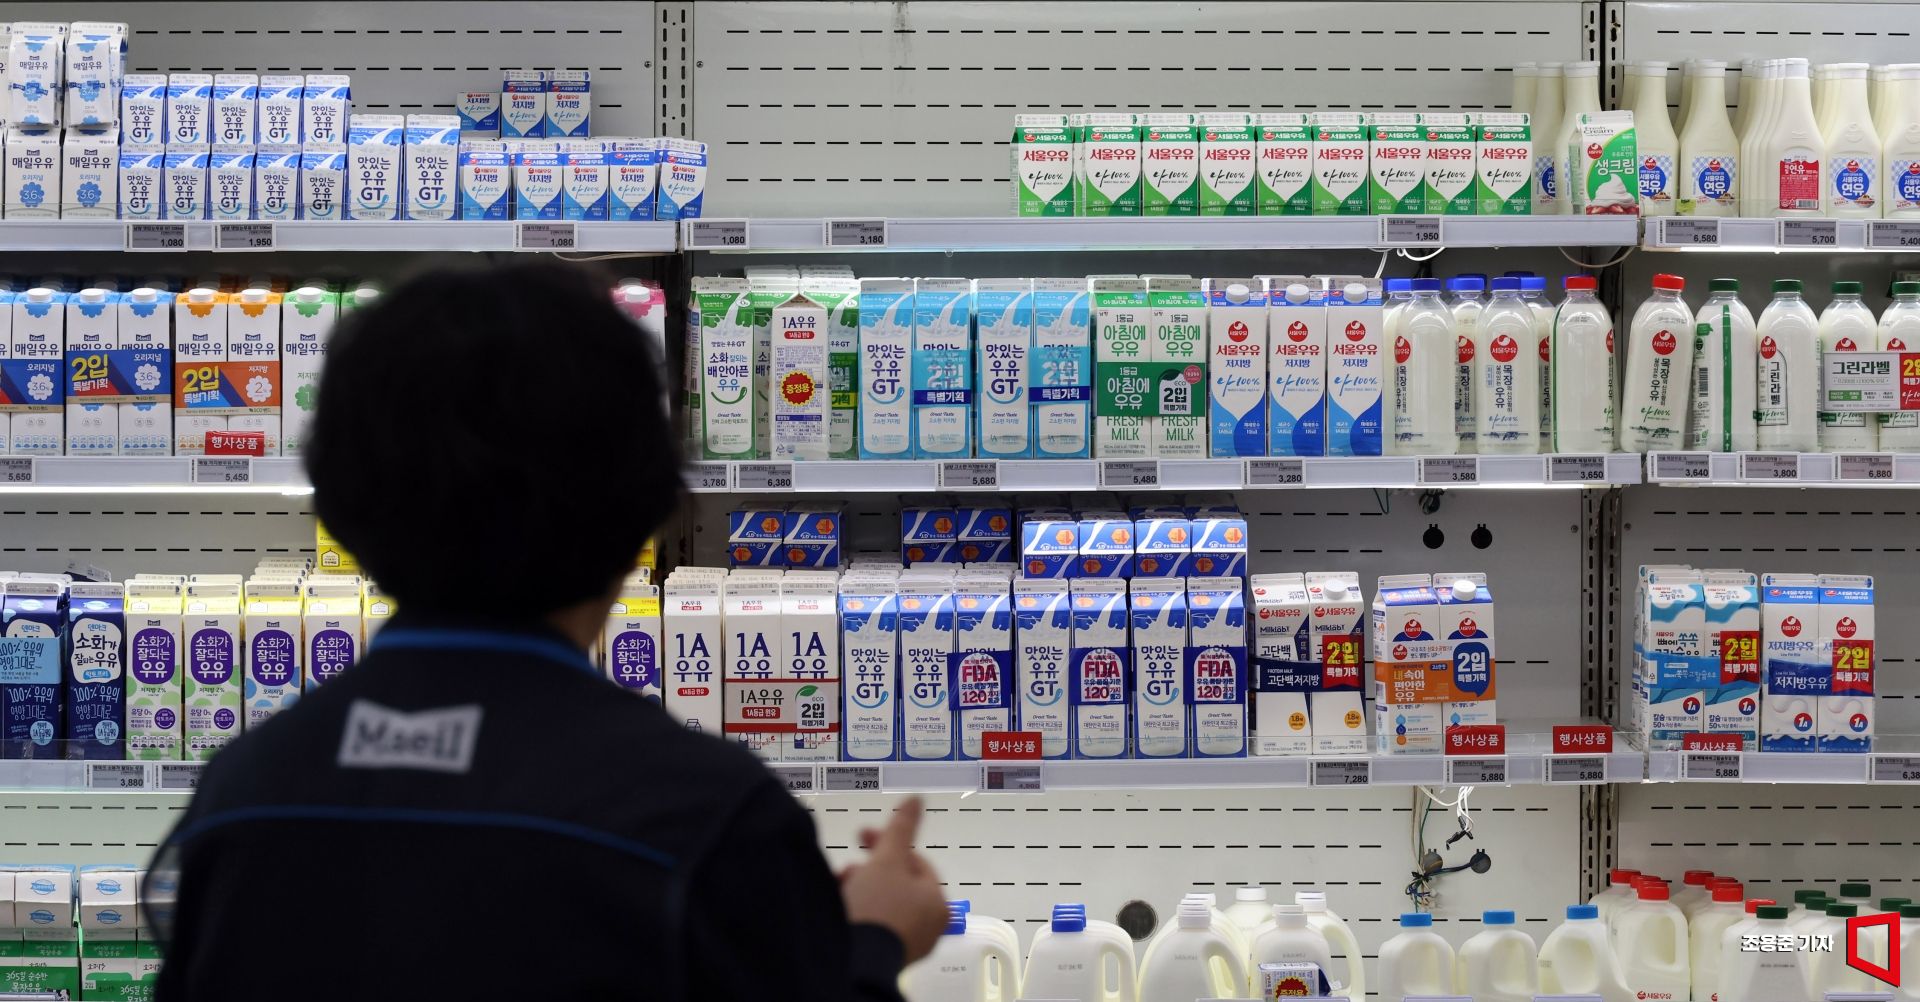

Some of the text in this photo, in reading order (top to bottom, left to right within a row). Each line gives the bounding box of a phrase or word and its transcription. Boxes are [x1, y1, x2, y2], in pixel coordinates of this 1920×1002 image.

[130, 105, 155, 116] 맛있는
[512, 101, 535, 109] 저지방
[132, 116, 152, 127] 우유
[132, 127, 151, 138] GT
[1024, 150, 1069, 162] 서울우유
[1090, 148, 1136, 161] 서울우유
[1148, 148, 1194, 161] 서울우유
[1375, 147, 1421, 160] 서울우유
[1426, 148, 1471, 161] 서울우유
[12, 157, 53, 169] 매일우유
[70, 157, 111, 169] 매일우유
[357, 157, 391, 171] 맛있는
[415, 157, 449, 171] 맛있는
[1595, 158, 1634, 175] 생크림
[218, 174, 244, 185] 맛있는
[360, 171, 386, 186] 우유
[418, 171, 444, 186] 우유
[220, 185, 240, 196] 우유
[360, 187, 385, 201] GT
[418, 187, 443, 201] GT
[1704, 181, 1725, 194] 연유
[1842, 183, 1864, 196] 연유
[221, 197, 239, 208] GT
[160, 238, 184, 248] 1,080
[248, 238, 272, 248] 1,950
[721, 236, 745, 245] 1,080
[860, 235, 883, 245] 3,180
[1415, 232, 1439, 242] 1,950
[1693, 234, 1717, 244] 6,580
[1812, 235, 1835, 244] 5,700
[781, 316, 816, 329] 1A우유
[1116, 314, 1134, 323] 1등급
[1170, 314, 1188, 323] 1등급
[1103, 324, 1146, 341] 아침에
[1158, 324, 1201, 341] 아침에
[15, 343, 59, 356] 매일우유
[178, 342, 223, 355] 매일우유
[231, 342, 276, 355] 매일우유
[867, 344, 906, 359] 맛있는
[985, 344, 1024, 359] 맛있는
[1166, 342, 1193, 357] 우유
[1216, 344, 1260, 356] 서울우유
[1275, 344, 1320, 356] 서울우유
[1333, 344, 1377, 355] 서울우유
[133, 352, 162, 363] 오리지널
[709, 352, 728, 364] 소화
[1225, 359, 1251, 368] 저지방
[1285, 359, 1310, 368] 저지방
[1343, 358, 1368, 368] 저지방
[26, 362, 55, 372] 오리지널
[71, 353, 109, 382] 2입
[707, 366, 750, 378] 배안아픈
[871, 360, 902, 377] 우유
[1119, 367, 1138, 376] 1등급
[1832, 361, 1890, 375] 그린라벨
[73, 379, 109, 392] 특별기획
[182, 365, 220, 394] 2입
[1107, 377, 1150, 395] 아침에
[1770, 362, 1781, 405] 그린라벨
[786, 383, 810, 394] 증정용
[872, 379, 900, 395] GT
[990, 379, 1019, 395] GT
[184, 390, 220, 404] 특별기획
[927, 391, 964, 403] 특별기획
[1042, 389, 1080, 400] 특별기획
[1114, 394, 1142, 410] 우유
[1106, 416, 1143, 427] FRESH
[1161, 416, 1198, 427] FRESH
[1111, 427, 1140, 441] MILK
[1165, 427, 1194, 441] MILK
[211, 435, 259, 450] 행사상품
[8, 472, 31, 482] 5,650
[225, 472, 249, 482] 5,450
[1133, 475, 1157, 484] 5,480
[1278, 474, 1302, 483] 3,280
[1452, 473, 1476, 481] 3,580
[1580, 471, 1604, 480] 3,650
[1685, 468, 1709, 478] 3,640
[1773, 468, 1797, 478] 3,800
[1868, 469, 1892, 479] 6,880
[702, 478, 726, 488] 3,780
[767, 478, 791, 488] 6,380
[972, 477, 996, 486] 5,680
[137, 635, 170, 648] 소화가
[195, 635, 228, 648] 소화가
[256, 637, 290, 649] 소화가
[316, 637, 349, 649] 소화가
[616, 638, 651, 651] 소화가
[676, 632, 711, 658] 1A
[736, 632, 772, 657] 1A
[791, 631, 827, 657] 1A
[1657, 638, 1677, 646] 뼈에
[1678, 632, 1698, 647] 쏙쏙
[1768, 641, 1814, 651] 저지방우유
[137, 648, 170, 660] 잘되는
[195, 648, 228, 661] 잘되는
[256, 649, 290, 662] 잘되는
[316, 649, 349, 662] 잘되는
[616, 651, 650, 664] 잘되는
[851, 648, 890, 664] 맛있는
[908, 648, 947, 664] 맛있는
[1025, 645, 1063, 661] 맛있는
[1141, 645, 1180, 661] 맛있는
[1261, 645, 1290, 658] 고단백
[1837, 646, 1869, 669] 2입
[1457, 651, 1486, 672] 2입
[140, 661, 167, 678] 우유
[259, 663, 287, 680] 우유
[855, 665, 886, 682] 우유
[913, 665, 943, 682] 우유
[962, 664, 997, 682] FDA
[1085, 660, 1120, 678] FDA
[1145, 662, 1176, 679] 우유
[1197, 660, 1233, 677] FDA
[1724, 663, 1757, 674] 특별기획
[1267, 675, 1319, 687] 고단백저지방
[1457, 674, 1486, 683] 특별기획
[1775, 677, 1828, 689] 저지방우유
[1836, 672, 1869, 682] 특별기획
[856, 683, 884, 699] GT
[913, 683, 941, 699] GT
[1030, 680, 1058, 697] GT
[1147, 680, 1175, 697] GT
[1197, 685, 1222, 699] 120
[1394, 680, 1425, 691] 편안한
[962, 690, 987, 703] 120
[1085, 686, 1109, 699] 120
[746, 708, 777, 718] 1A등급 원유
[1653, 713, 1665, 721] 칼슘
[1709, 714, 1720, 722] 칼슘
[1451, 733, 1500, 747] 행사상품
[1560, 731, 1606, 746] 행사상품
[988, 740, 1036, 753] 행사상품
[1344, 774, 1368, 784] 7,280
[1480, 772, 1505, 782] 5,880
[1579, 771, 1603, 780] 5,880
[1715, 768, 1739, 777] 5,880
[120, 777, 143, 787] 3,880
[788, 780, 812, 789] 4,980
[855, 780, 878, 789] 2,970
[5, 972, 48, 982] 365일 순수한
[1646, 992, 1672, 1000] 서울우유
